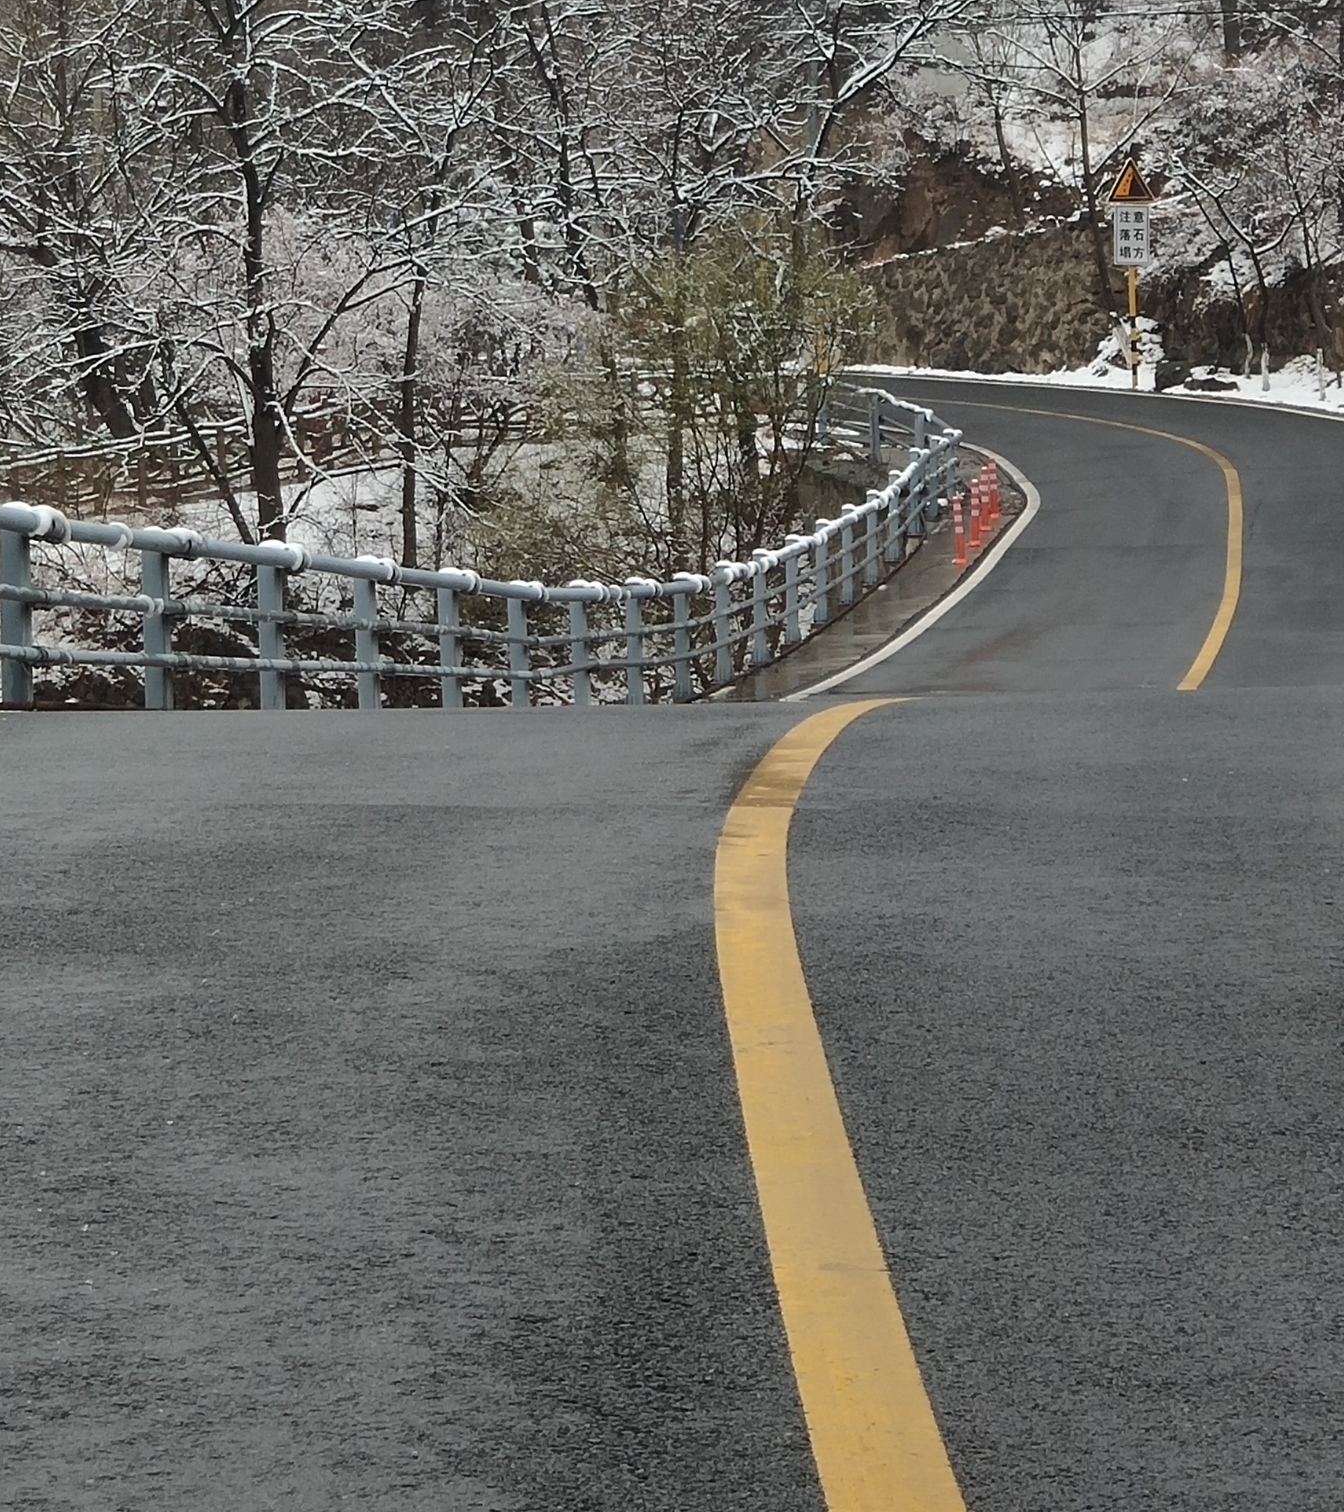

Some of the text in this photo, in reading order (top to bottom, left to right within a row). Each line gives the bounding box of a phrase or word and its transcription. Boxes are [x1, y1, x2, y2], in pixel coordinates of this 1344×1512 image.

[1119, 210, 1144, 224] 注意
[1119, 228, 1145, 241] 落石
[1119, 246, 1145, 259] 塌方
